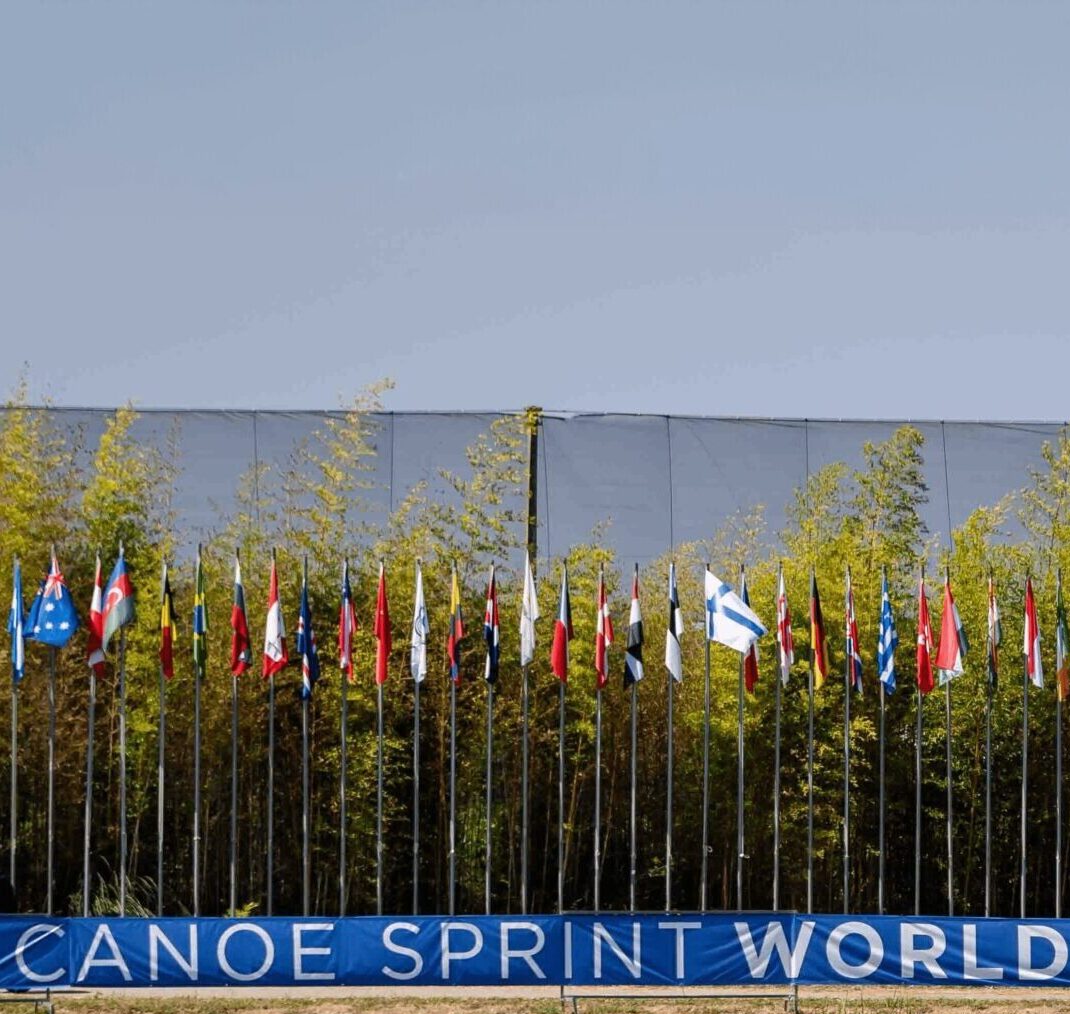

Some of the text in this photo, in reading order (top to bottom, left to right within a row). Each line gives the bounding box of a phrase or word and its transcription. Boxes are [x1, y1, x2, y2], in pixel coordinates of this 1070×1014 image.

[15, 922, 336, 983] CANOE
[382, 921, 702, 981] SPRINT
[735, 921, 1069, 982] WORLD
